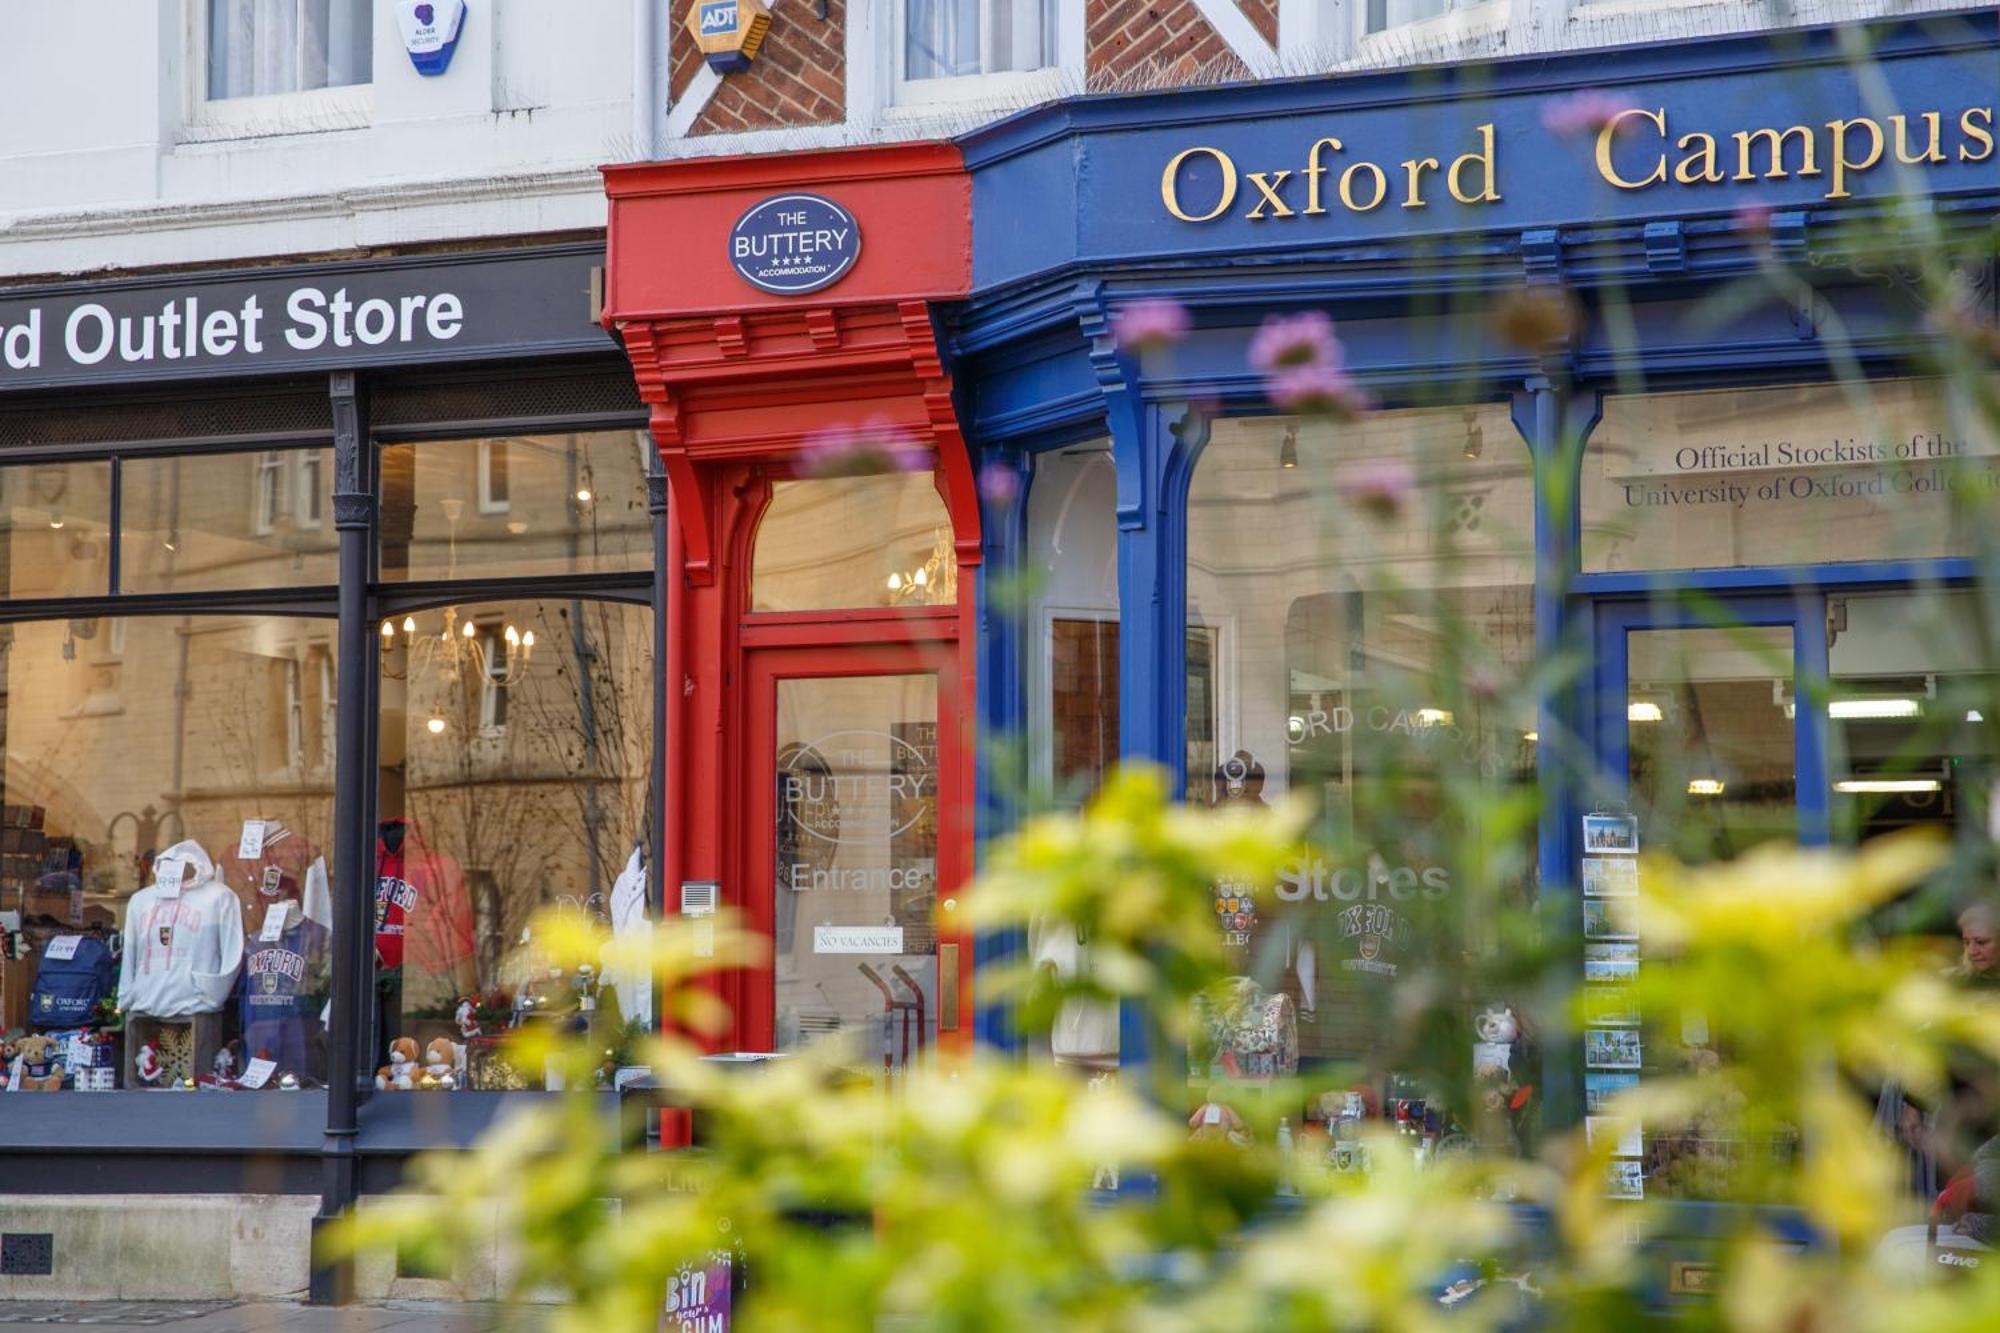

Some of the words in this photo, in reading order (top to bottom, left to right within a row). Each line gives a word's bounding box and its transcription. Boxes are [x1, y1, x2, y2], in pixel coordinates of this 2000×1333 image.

[702, 7, 736, 28] ADT
[1161, 122, 1501, 222] Oxford
[1595, 107, 1995, 199] Campus
[777, 211, 807, 226] THE
[735, 228, 848, 258] BUTTERY
[758, 265, 827, 278] ACCOMMODATION
[0, 308, 41, 369] d
[64, 293, 263, 366] Outlet
[284, 287, 464, 350] Store
[1675, 443, 1770, 470] Official
[1778, 438, 1887, 466] Stockists
[1894, 434, 1924, 459] of
[1926, 432, 1967, 457] the
[1623, 479, 1751, 509] University
[1758, 477, 1784, 501] of
[1788, 471, 1884, 500] Oxford
[786, 774, 928, 802] BUTTERY
[791, 863, 921, 891] Entrance
[1274, 853, 1450, 901] Stores
[820, 935, 837, 947] NO
[840, 935, 899, 947] VACANCIES
[1937, 1252, 1979, 1269] drive
[666, 1270, 705, 1313] Bin
